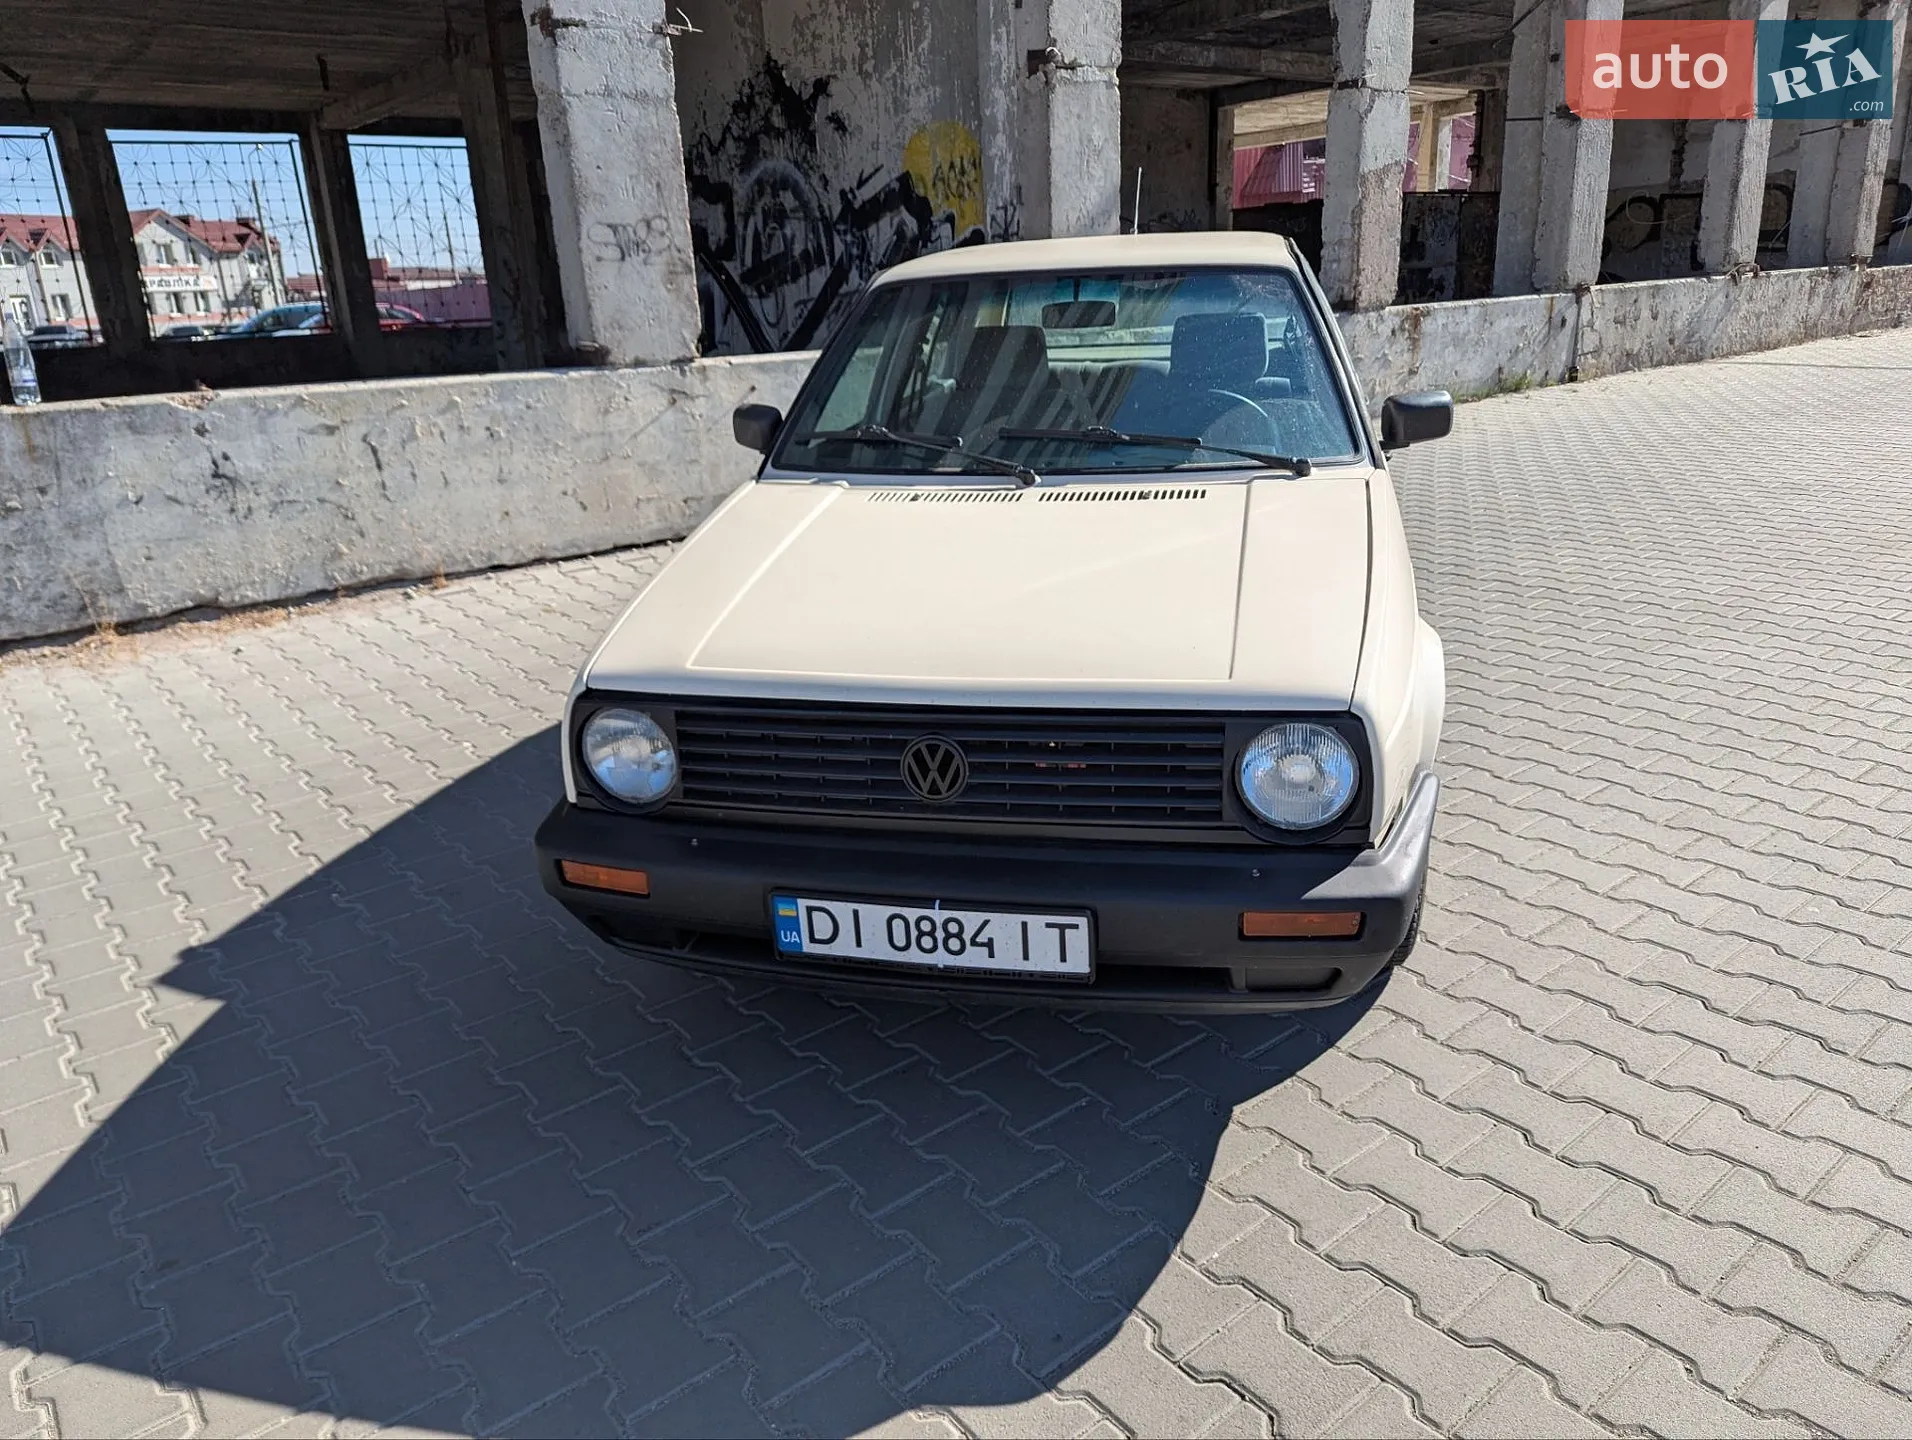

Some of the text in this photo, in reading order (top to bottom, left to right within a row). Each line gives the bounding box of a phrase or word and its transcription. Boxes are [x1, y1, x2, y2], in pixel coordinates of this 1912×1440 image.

[780, 929, 801, 944] UA
[805, 905, 1080, 963] DI 0884 IT
